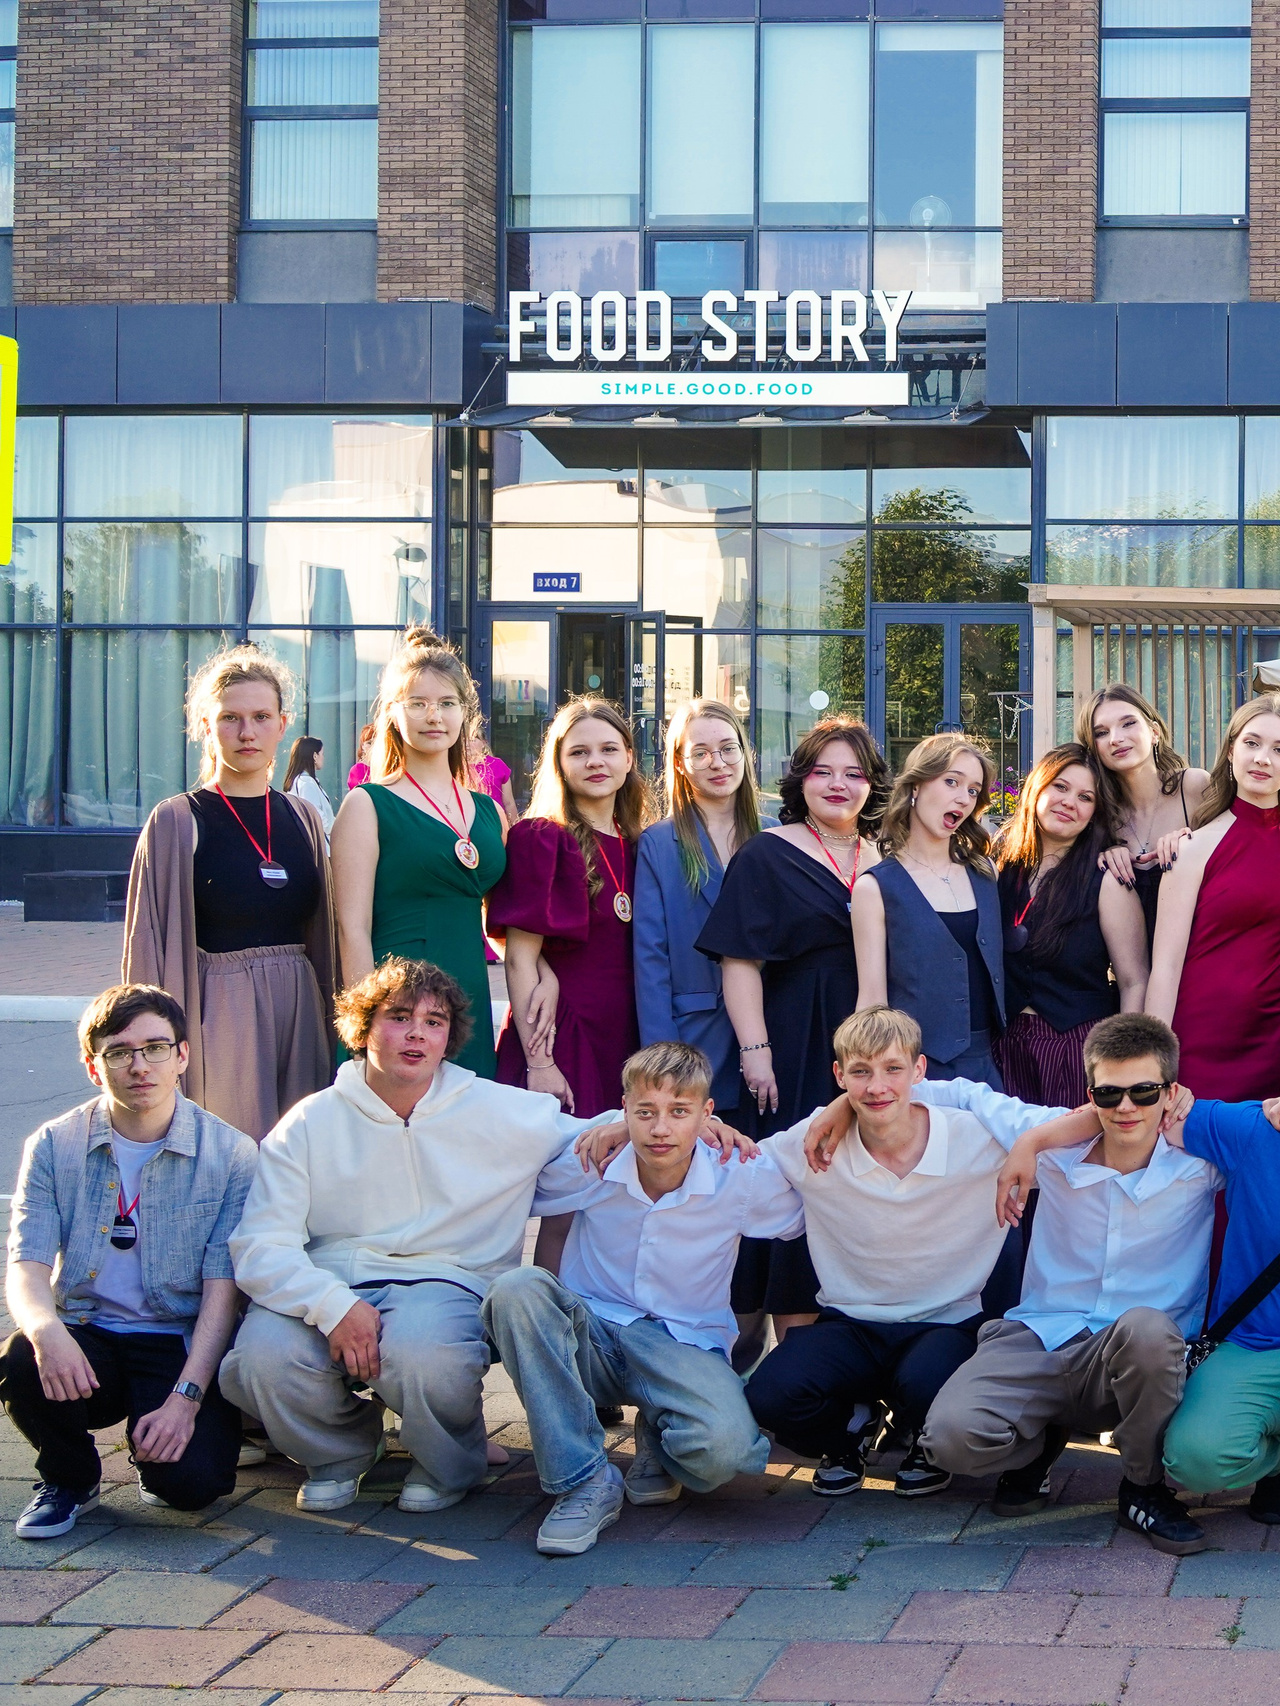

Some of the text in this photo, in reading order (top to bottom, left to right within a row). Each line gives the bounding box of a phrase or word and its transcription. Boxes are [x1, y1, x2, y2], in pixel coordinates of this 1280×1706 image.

[509, 290, 913, 361] FOOD STORY
[601, 383, 813, 395] SIMPLE.GOOD.FOOD
[570, 576, 577, 588] 7
